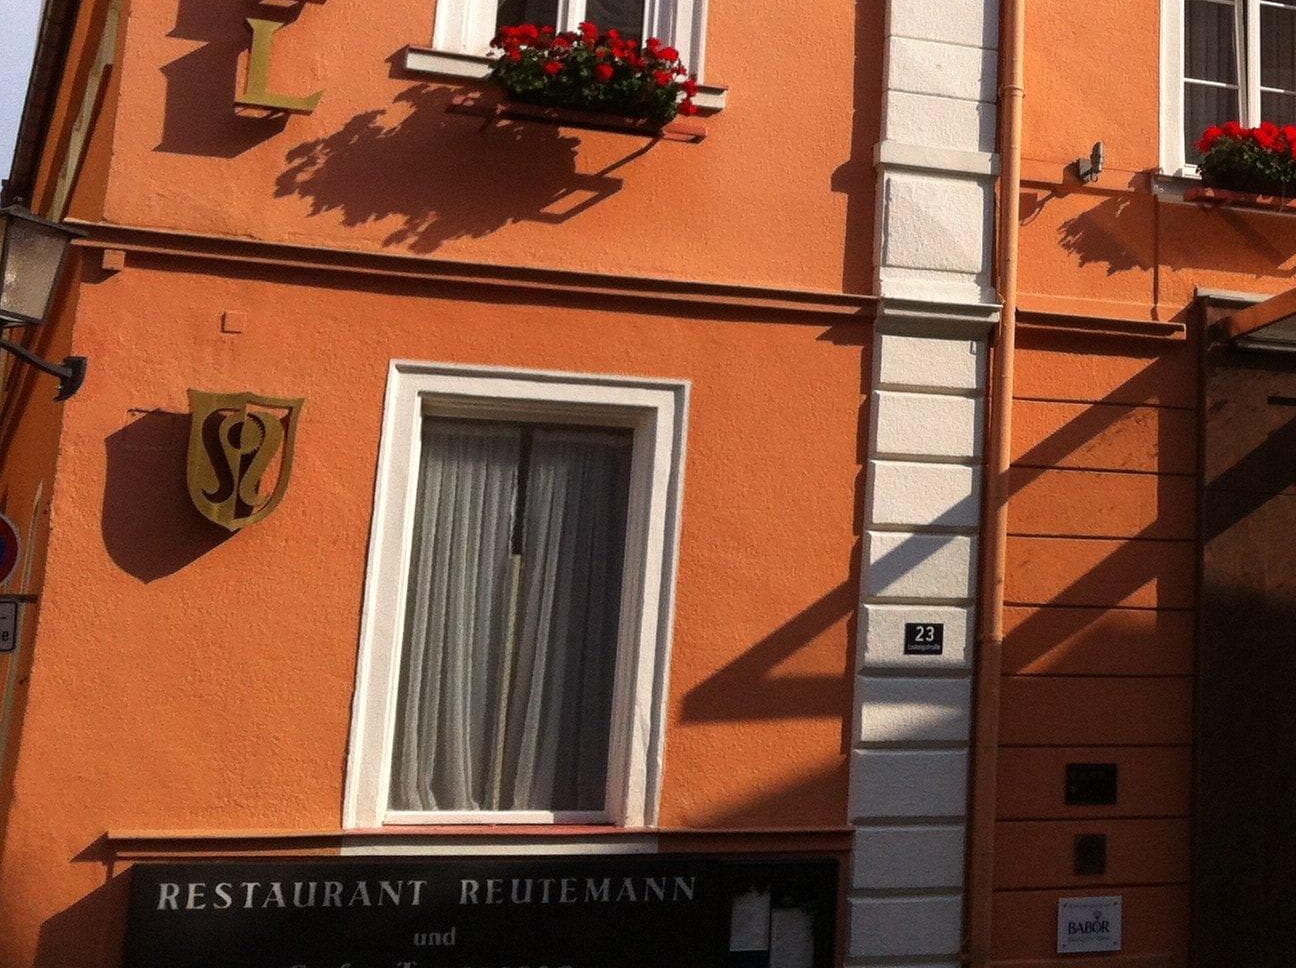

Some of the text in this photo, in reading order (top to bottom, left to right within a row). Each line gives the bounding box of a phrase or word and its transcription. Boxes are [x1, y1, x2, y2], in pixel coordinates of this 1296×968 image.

[914, 625, 935, 642] 23
[156, 876, 697, 911] RESTAURANT REUTEMANN
[413, 926, 456, 946] und
[1067, 919, 1110, 935] BABOR
